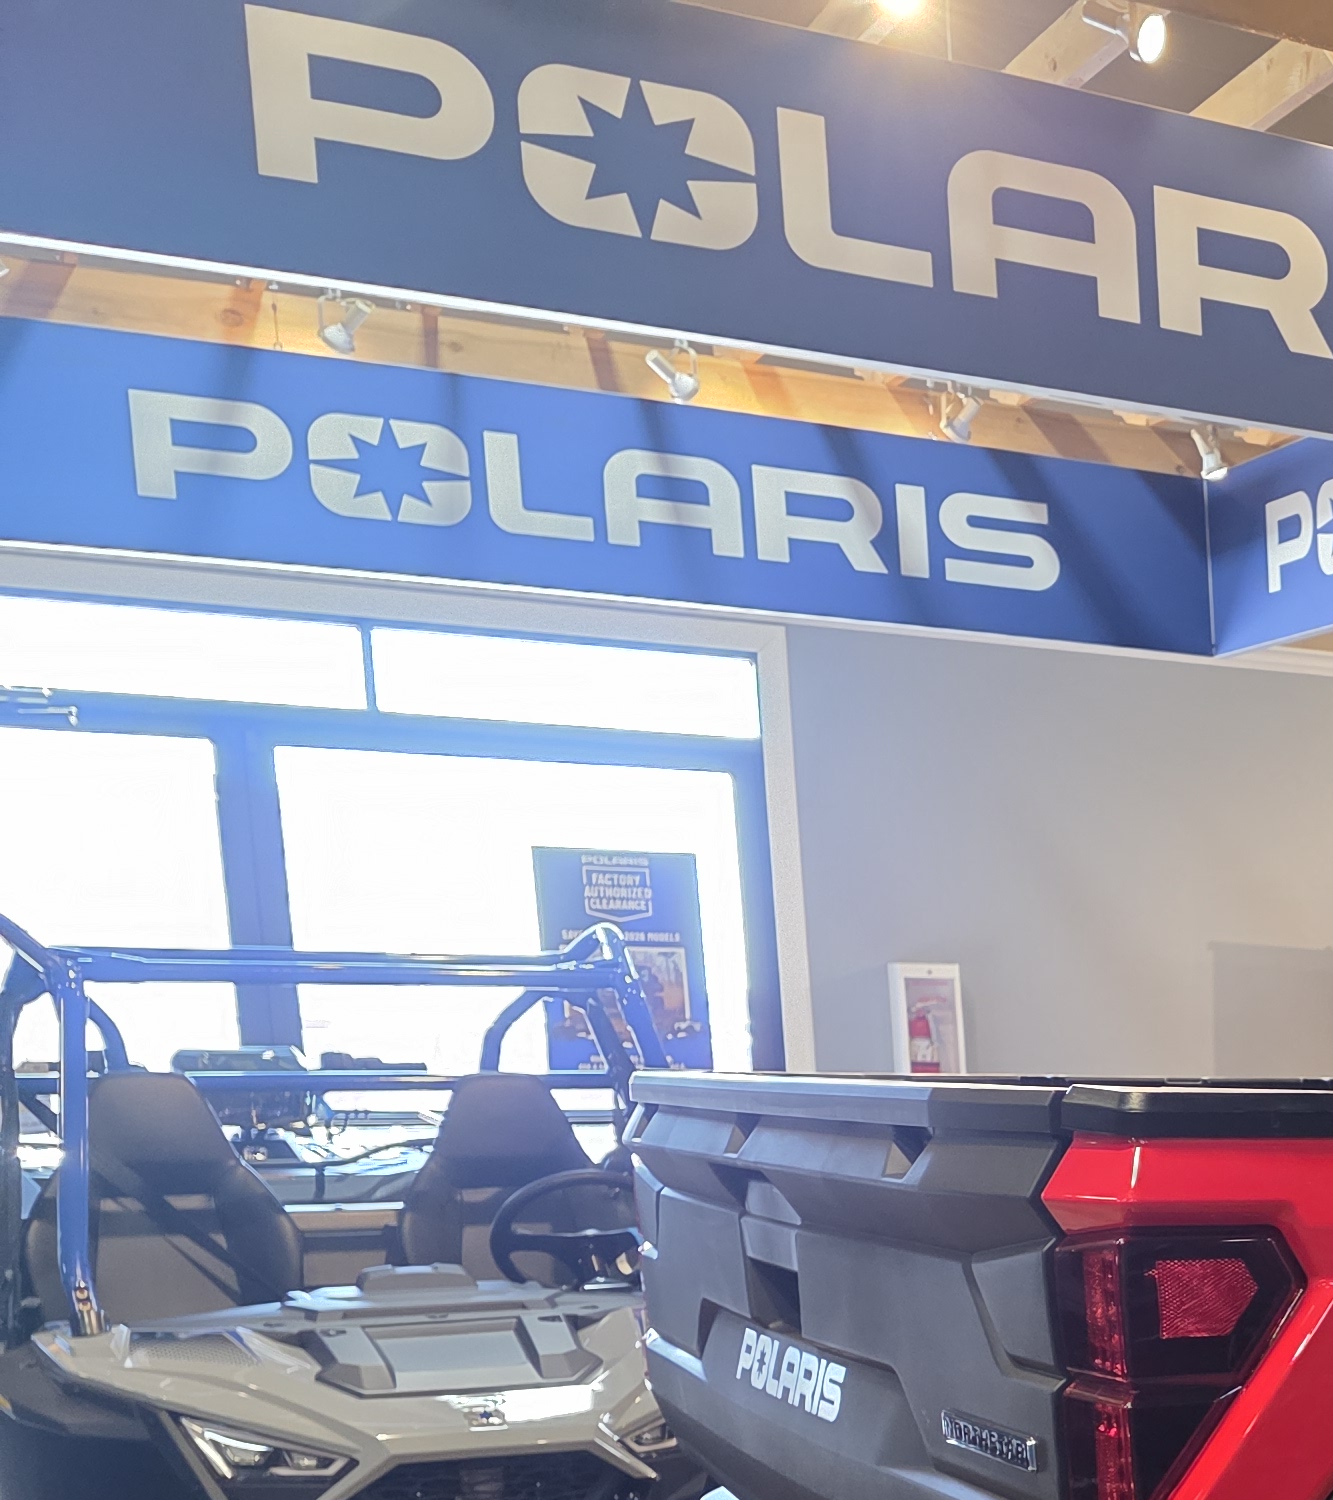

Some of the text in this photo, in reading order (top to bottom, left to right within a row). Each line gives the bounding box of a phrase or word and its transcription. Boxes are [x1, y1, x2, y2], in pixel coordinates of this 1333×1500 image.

[128, 389, 1061, 592] POLARIS
[591, 872, 640, 887] FACTORY
[584, 885, 652, 899] AUTHORIZED
[589, 897, 648, 911] CLEARANCE
[736, 1327, 847, 1423] POLARIS
